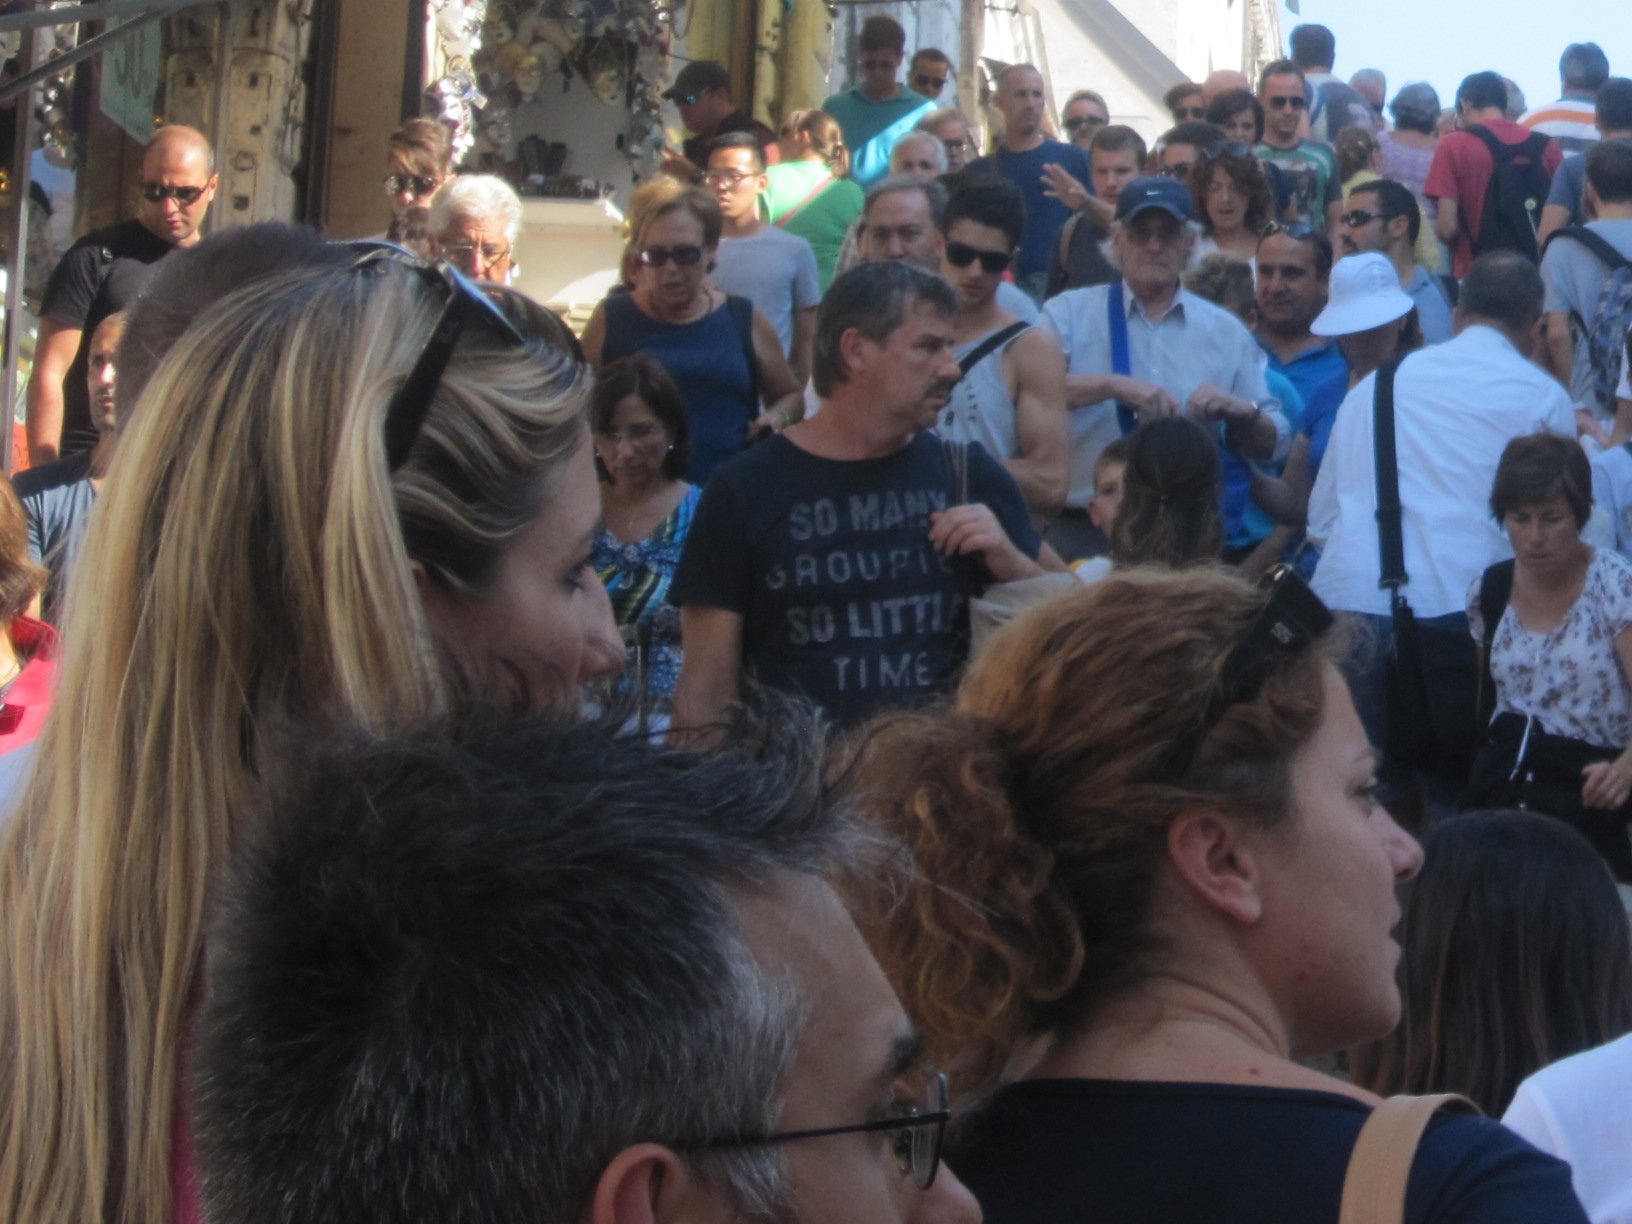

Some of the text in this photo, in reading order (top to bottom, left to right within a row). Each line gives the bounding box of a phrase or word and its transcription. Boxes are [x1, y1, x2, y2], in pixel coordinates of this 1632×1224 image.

[789, 489, 948, 542] SO MANY
[786, 604, 836, 647] SO
[833, 651, 932, 691] TIME
